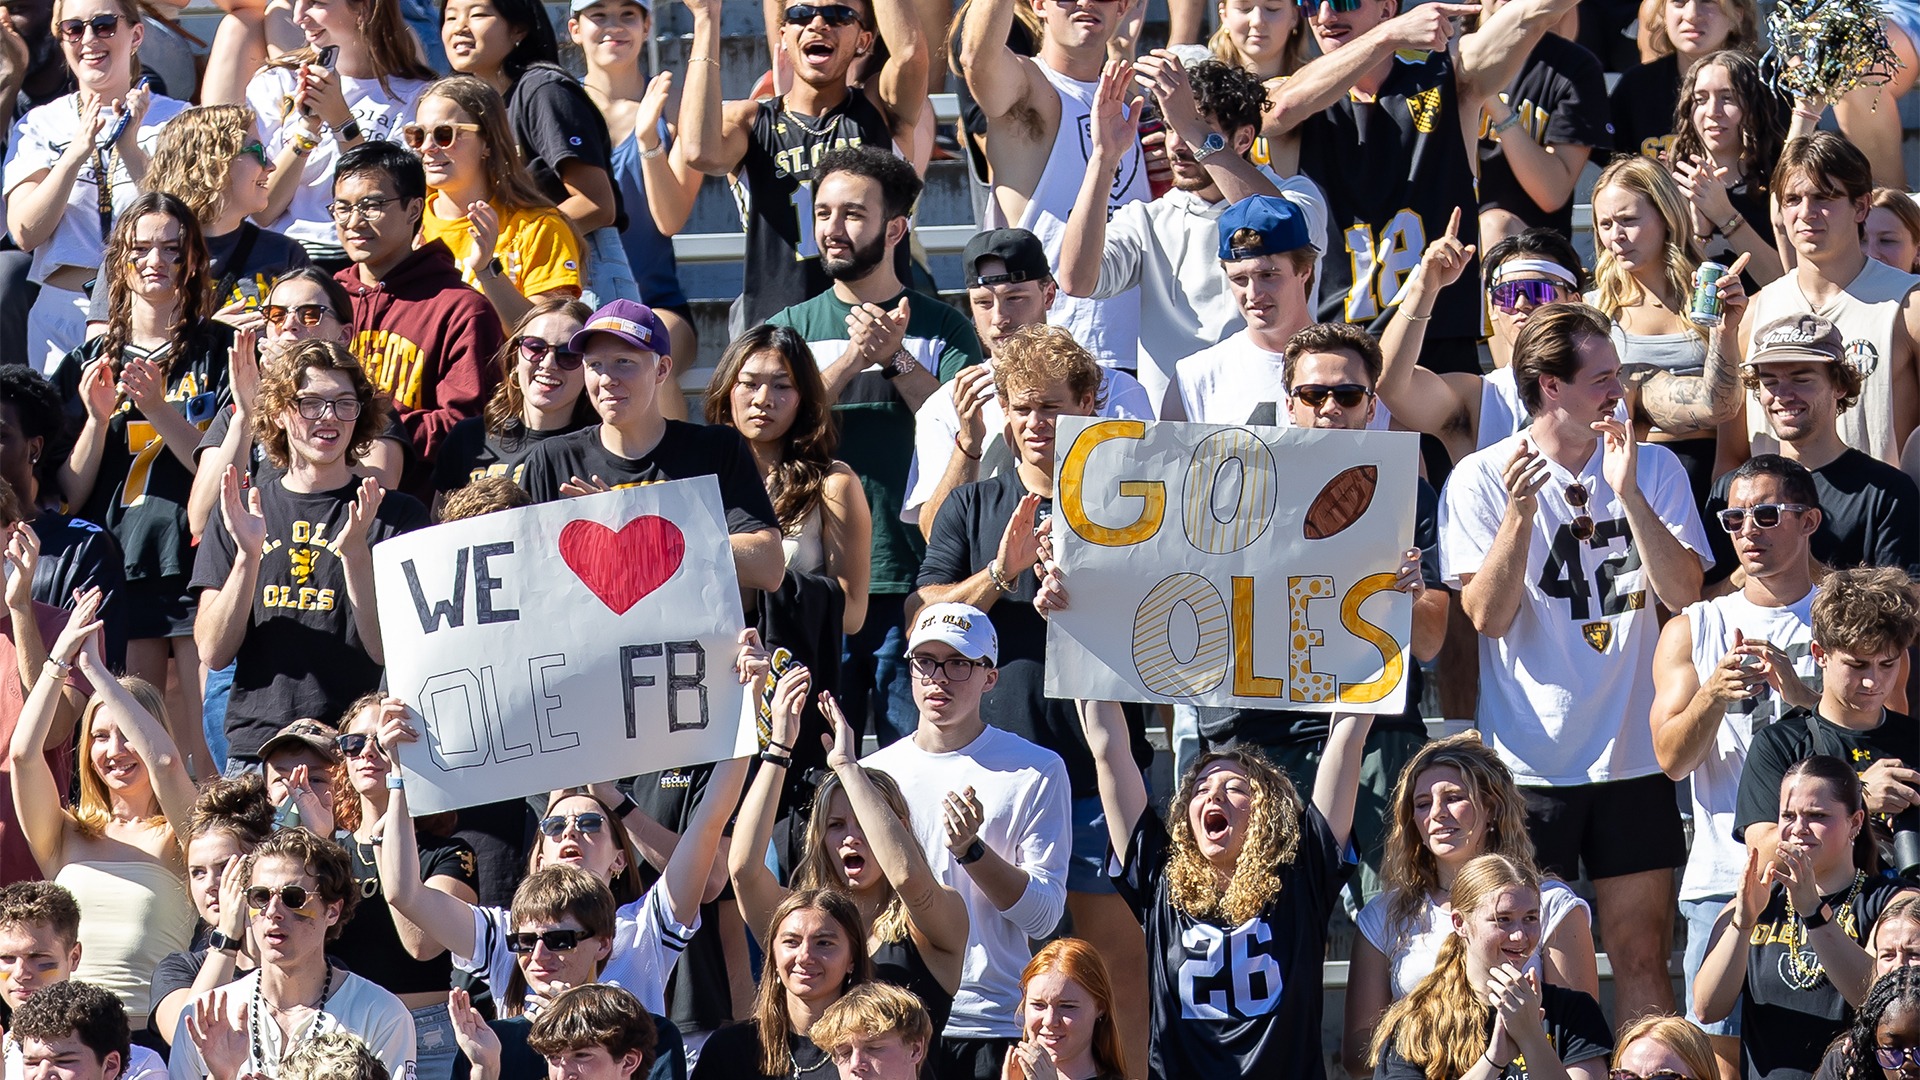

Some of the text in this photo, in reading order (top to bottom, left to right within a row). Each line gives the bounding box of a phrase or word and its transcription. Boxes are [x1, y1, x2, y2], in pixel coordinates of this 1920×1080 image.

[1344, 208, 1426, 323] 18
[1058, 420, 1278, 554] GO
[263, 585, 335, 611] OLES
[401, 541, 520, 634] WE
[1537, 516, 1643, 621] 42
[942, 614, 972, 632] OLAF
[1132, 572, 1404, 704] OLES
[418, 639, 709, 771] OLE FB
[1178, 917, 1283, 1020] 26
